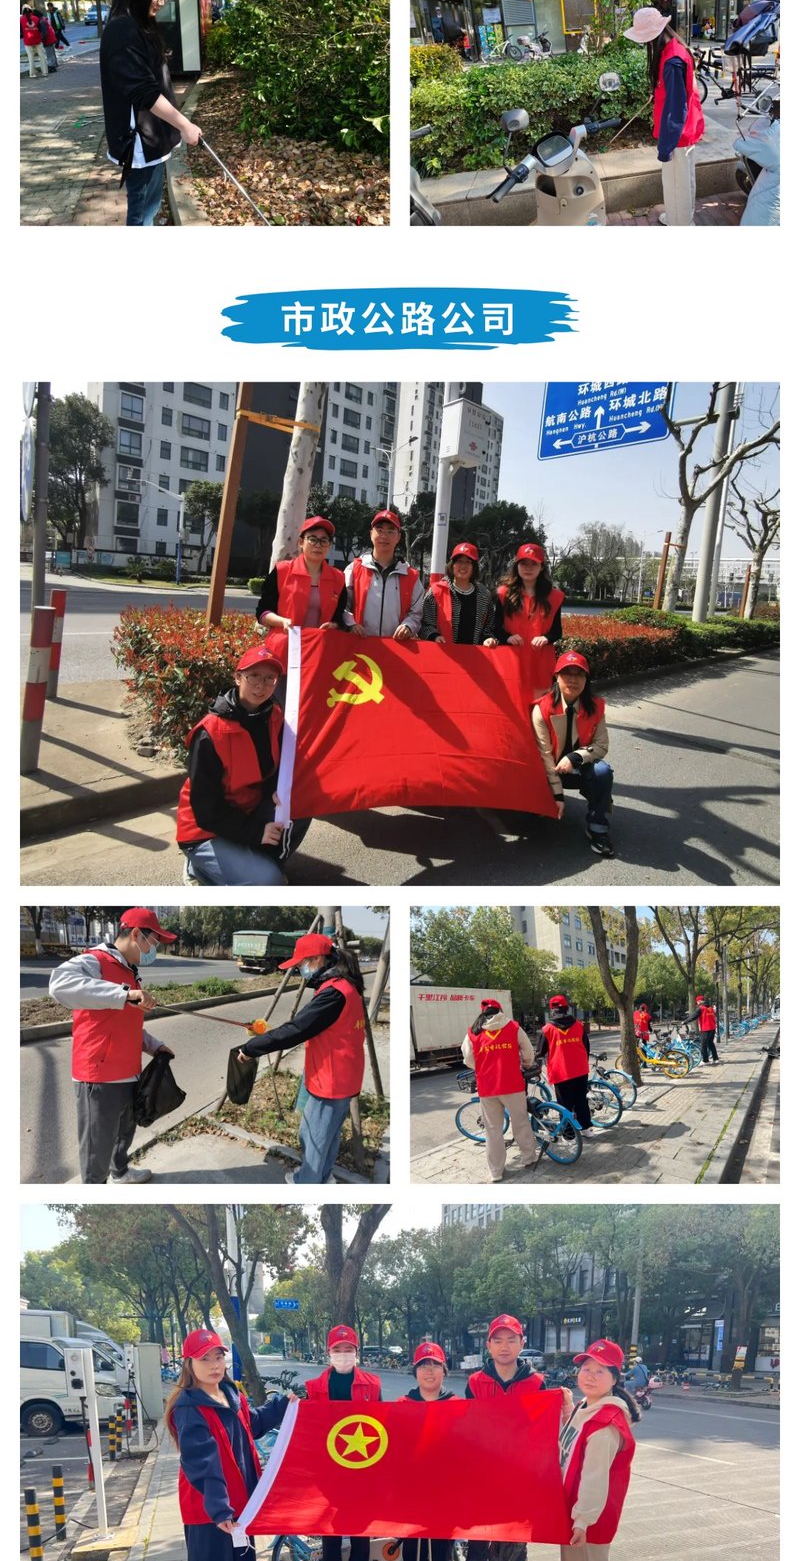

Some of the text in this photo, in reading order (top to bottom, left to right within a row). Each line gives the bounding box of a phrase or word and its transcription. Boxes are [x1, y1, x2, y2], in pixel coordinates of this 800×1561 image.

[608, 386, 668, 411] 环城北路
[545, 406, 592, 428] 航南公路
[577, 428, 618, 445] 沪杭公路
